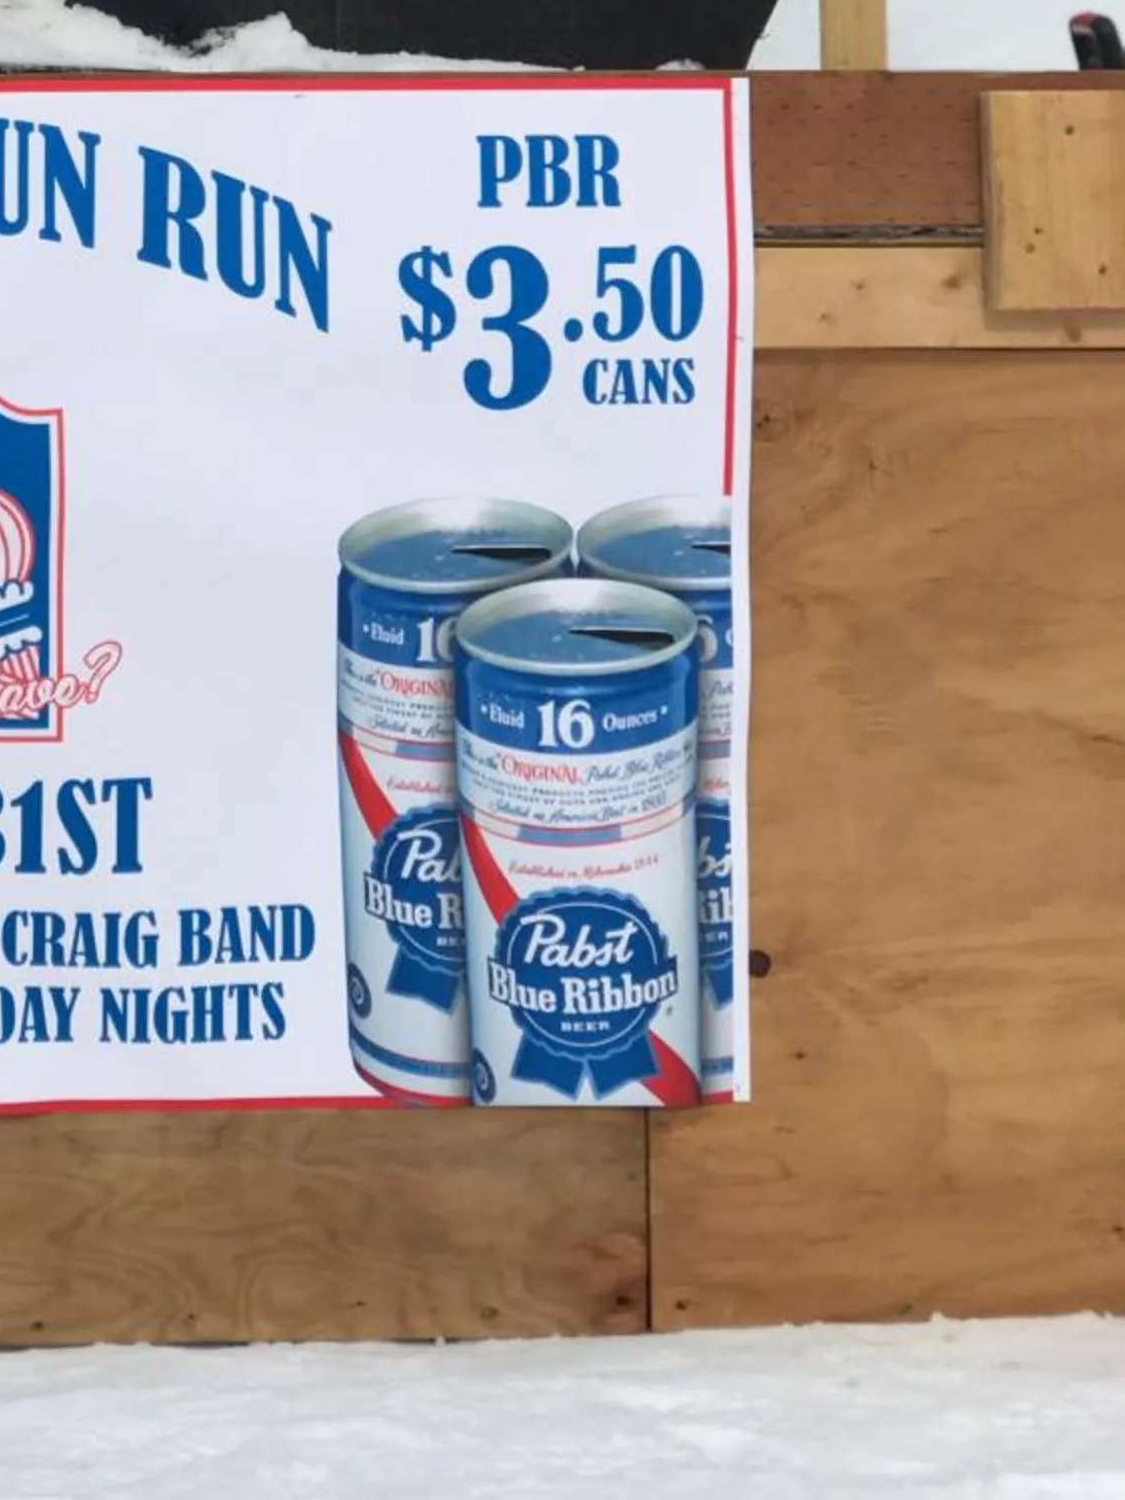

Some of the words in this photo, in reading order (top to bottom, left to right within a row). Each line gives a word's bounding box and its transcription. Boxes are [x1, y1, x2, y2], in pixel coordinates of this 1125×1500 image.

[476, 134, 621, 209] PBR
[137, 145, 332, 333] RUN
[398, 245, 704, 411] $3.50
[582, 359, 696, 405] CANS
[370, 622, 405, 646] Fluid
[489, 704, 524, 728] Fluid
[537, 700, 595, 749] 16
[602, 712, 658, 732] Ounces
[365, 876, 433, 929] Blue
[2, 912, 159, 968] CRAIG
[179, 904, 316, 967] BAND
[520, 913, 638, 968] Pabst
[100, 984, 286, 1043] NIGHTS
[489, 960, 557, 1013] Blue
[561, 970, 676, 1014] Ribbon
[561, 1020, 611, 1032] BEER
